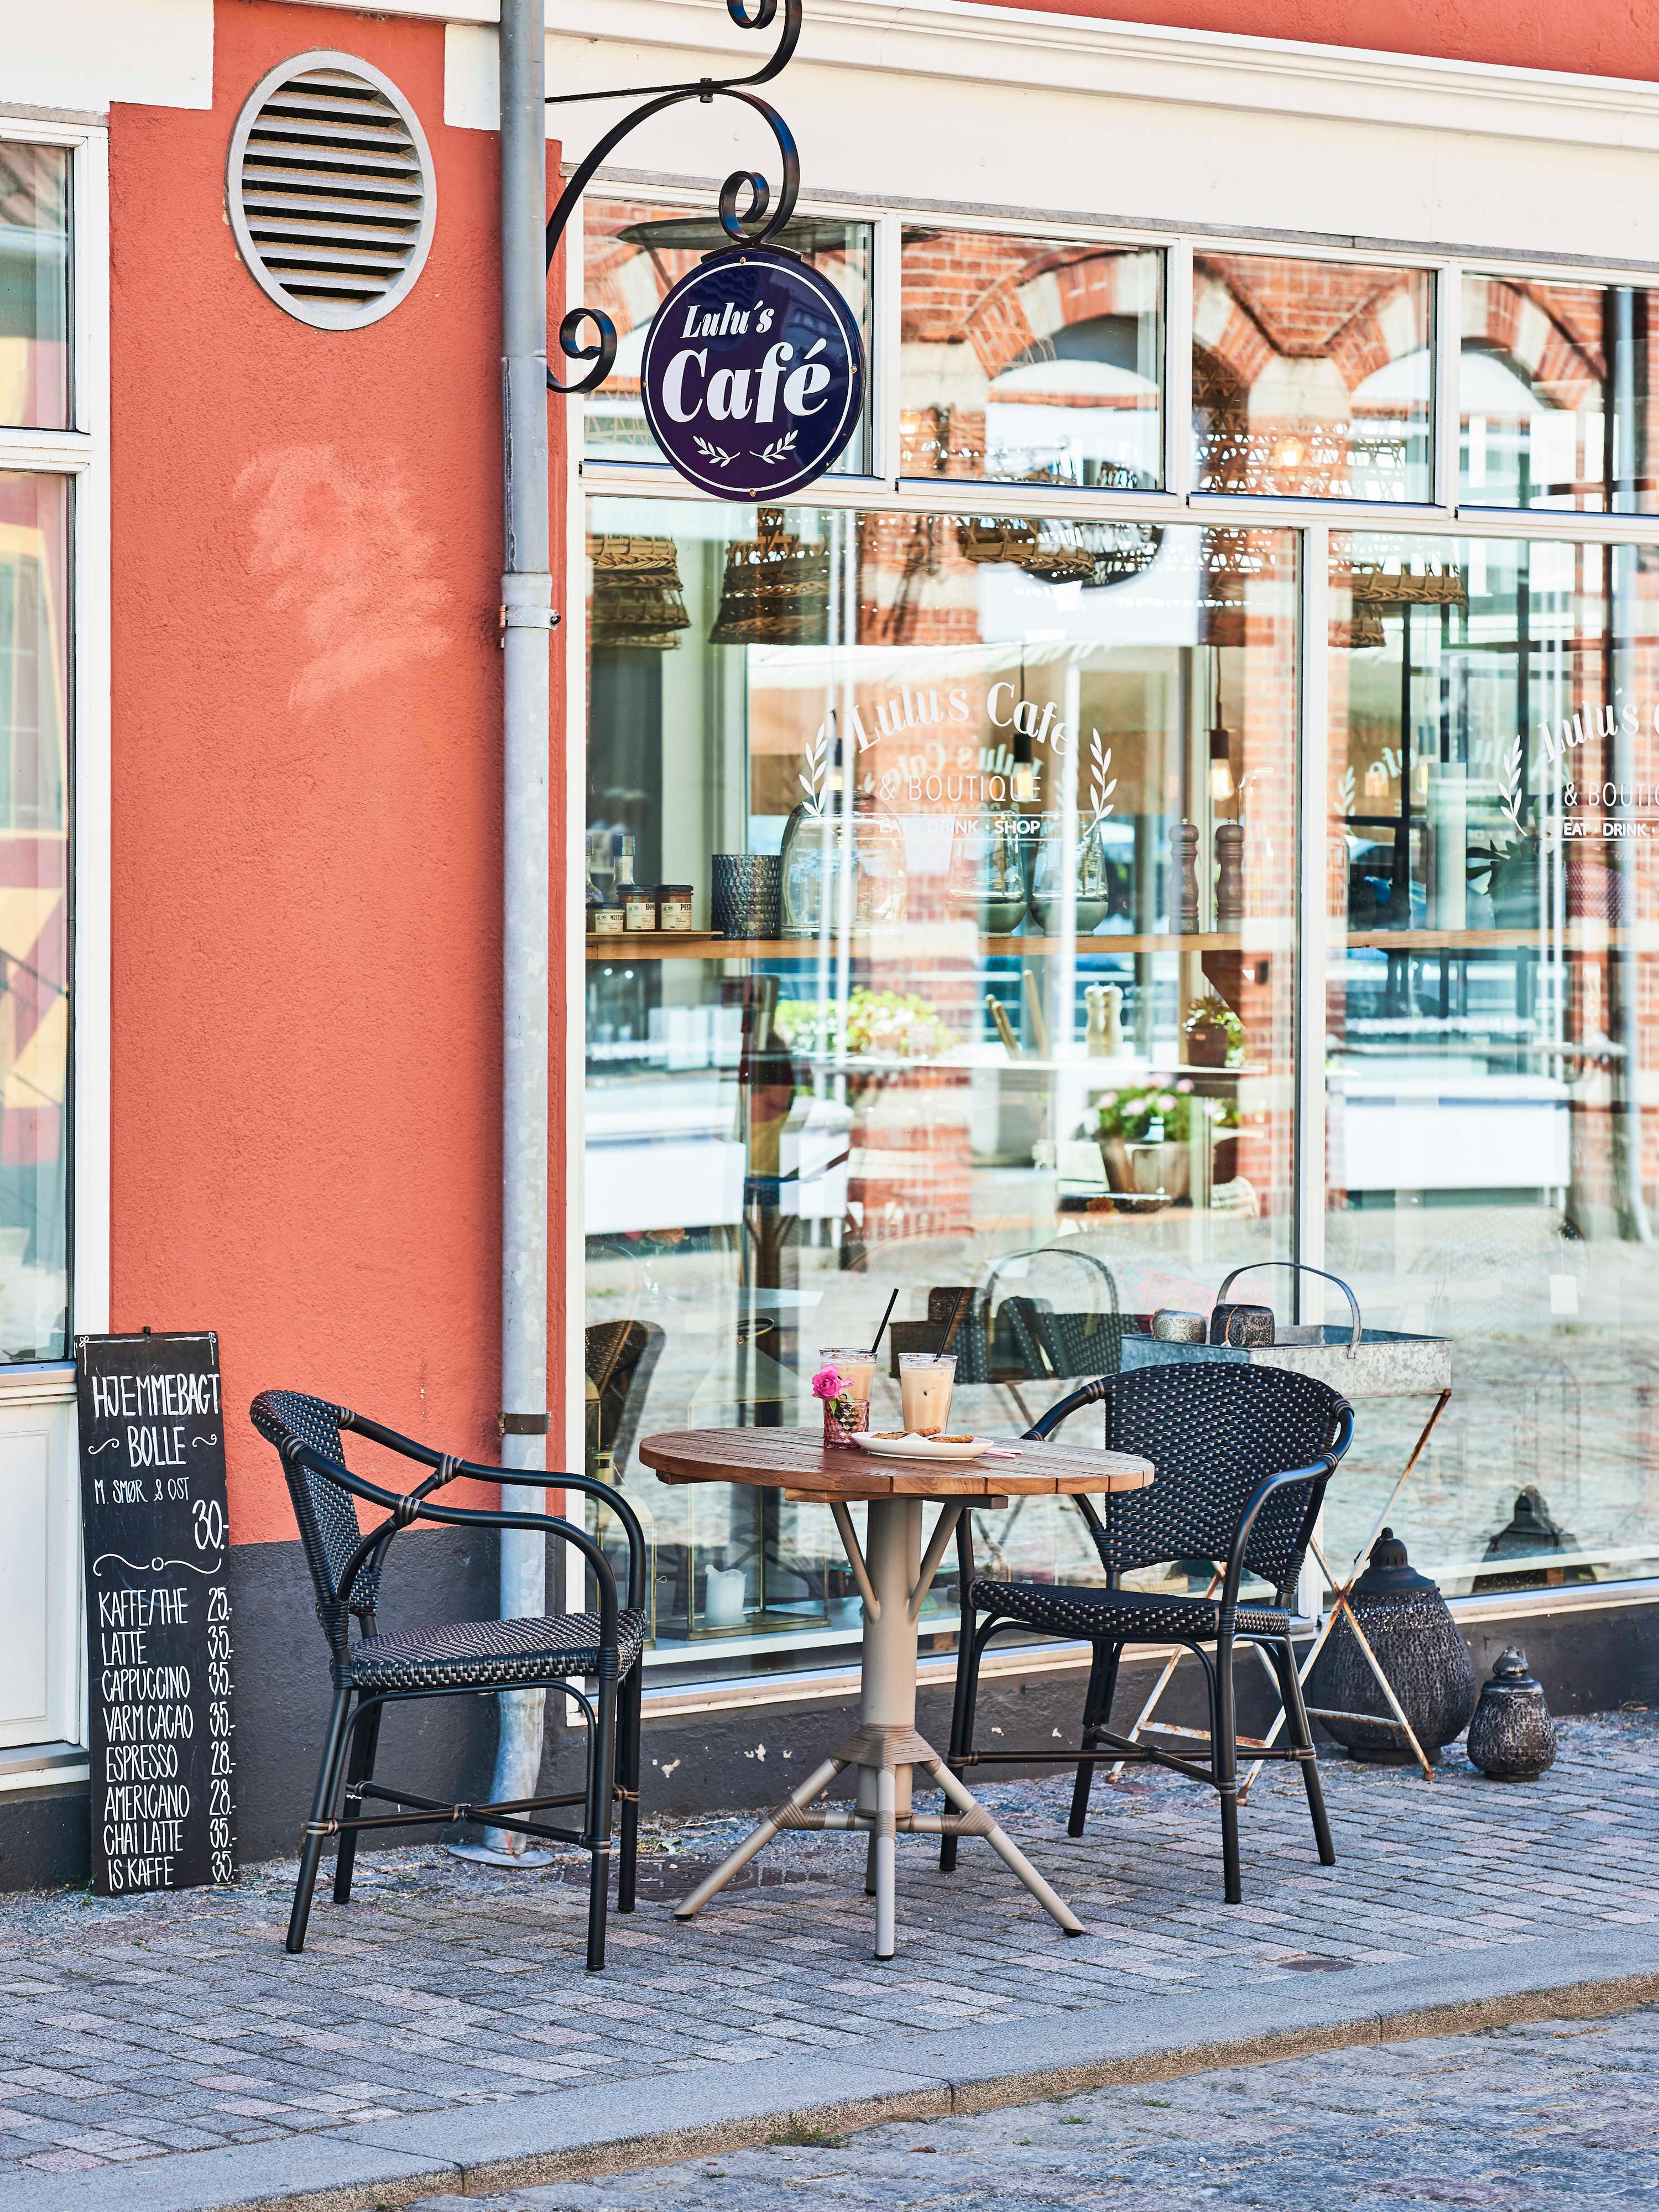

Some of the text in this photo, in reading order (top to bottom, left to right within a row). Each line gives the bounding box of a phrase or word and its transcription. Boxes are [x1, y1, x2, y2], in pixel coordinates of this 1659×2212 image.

[680, 300, 775, 338] Lulu's
[662, 338, 831, 423] Café
[1538, 687, 1640, 763] Lulu's
[879, 775, 1042, 802] & BOUTIQUE
[1564, 781, 1659, 807] & BOUTI
[995, 820, 1041, 834] SHOP
[1564, 822, 1646, 837] EAT DRINK
[92, 1373, 220, 1417] HJEMMEBAGT
[127, 1426, 187, 1467] BOLLE
[112, 1479, 148, 1504] SMØR
[168, 1477, 190, 1501] OST
[98, 1588, 189, 1628] KAFFE/THE
[102, 1666, 190, 1702] CAPPUCCINO
[102, 1704, 144, 1743] VARM
[147, 1704, 194, 1740] CACAO
[106, 1744, 178, 1782] ESPRESSO
[104, 1783, 190, 1822] AMERICANO
[103, 1822, 138, 1856] CHAI
[143, 1819, 184, 1854] LATTE
[127, 1856, 174, 1887] KAFFE
